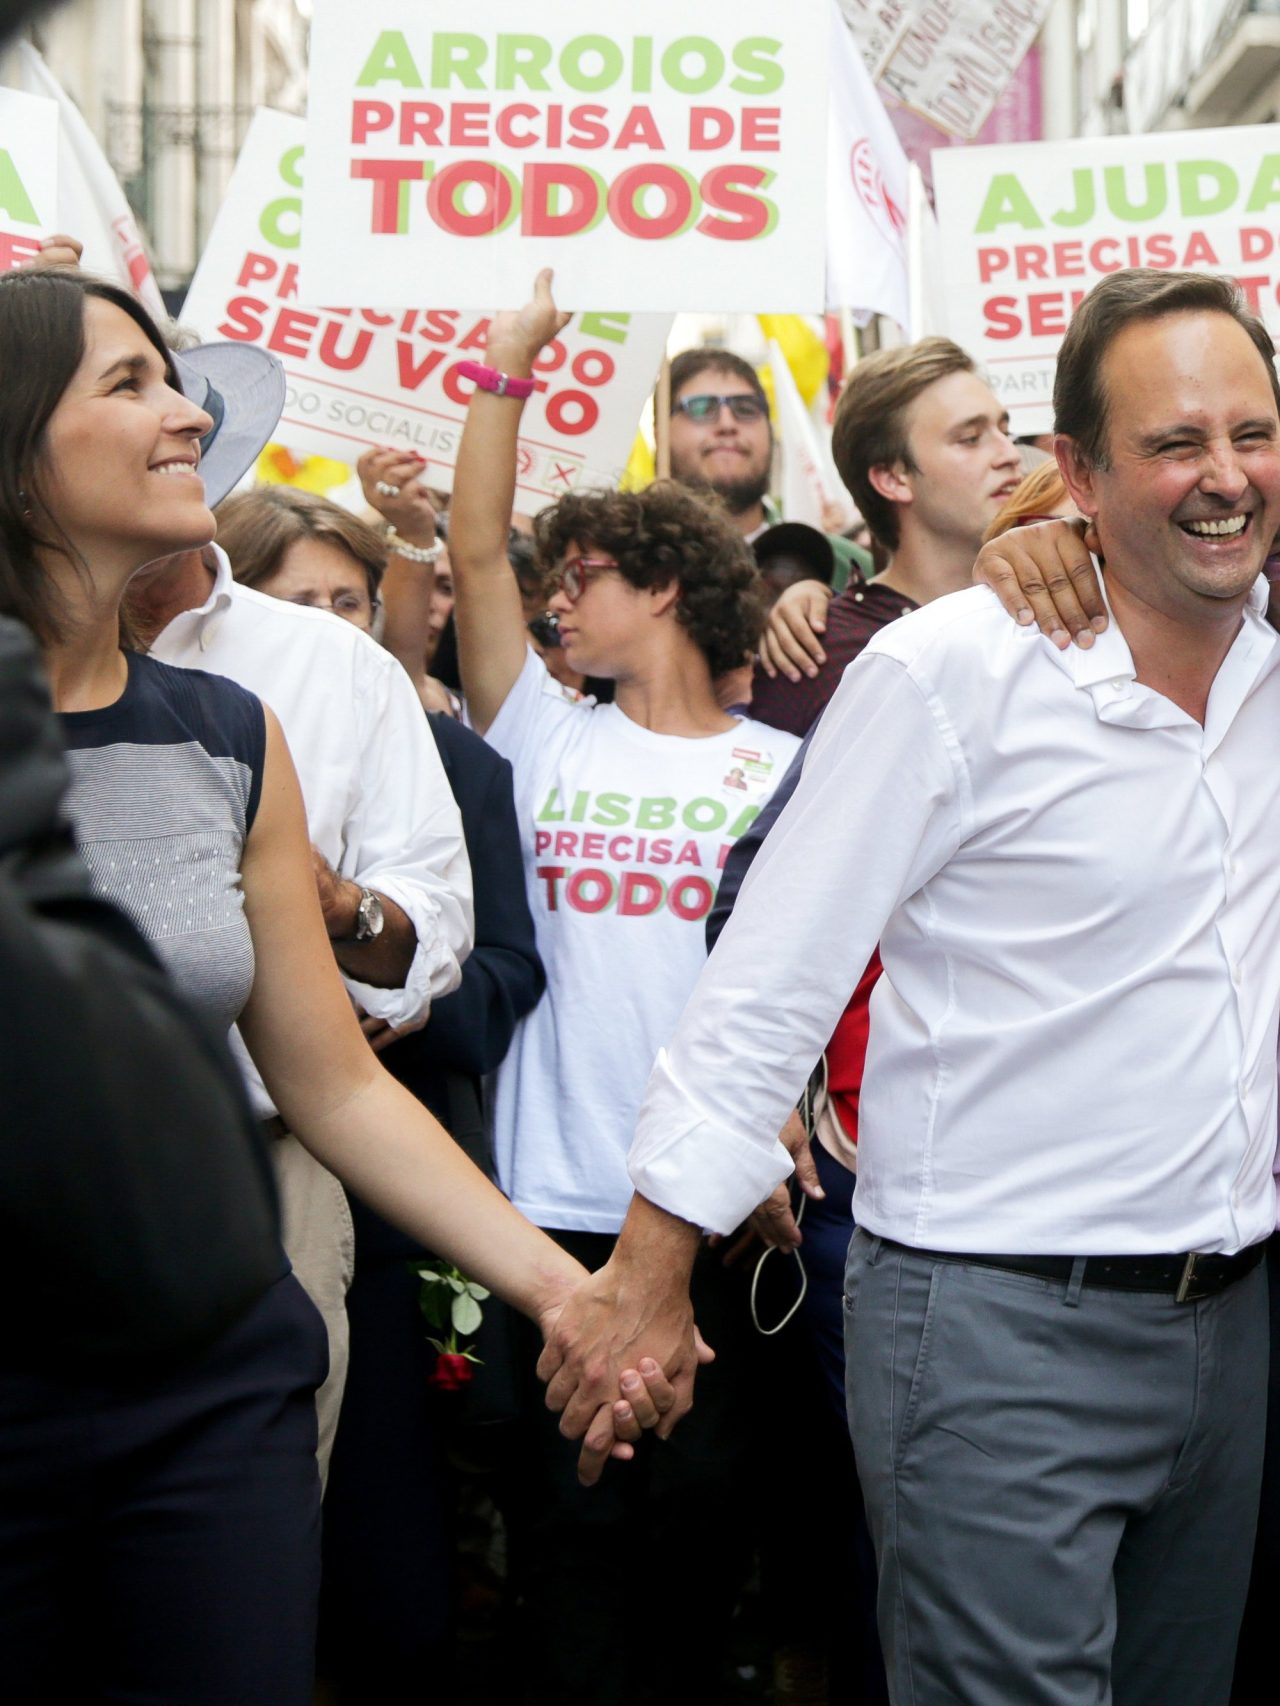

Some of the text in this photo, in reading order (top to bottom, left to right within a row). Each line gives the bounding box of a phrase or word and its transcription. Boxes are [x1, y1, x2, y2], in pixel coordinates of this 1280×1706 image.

[354, 29, 785, 95] ARROIOS
[351, 100, 781, 152] PRECISA DE
[350, 158, 780, 241] TODOS
[977, 231, 1219, 283] PRECISA
[983, 290, 1084, 340] SE
[217, 296, 598, 435] SEU VOO
[987, 370, 1052, 392] PART
[327, 400, 456, 452] SOCIALIS
[535, 830, 702, 869] PRECISA
[536, 866, 718, 922] TODO
